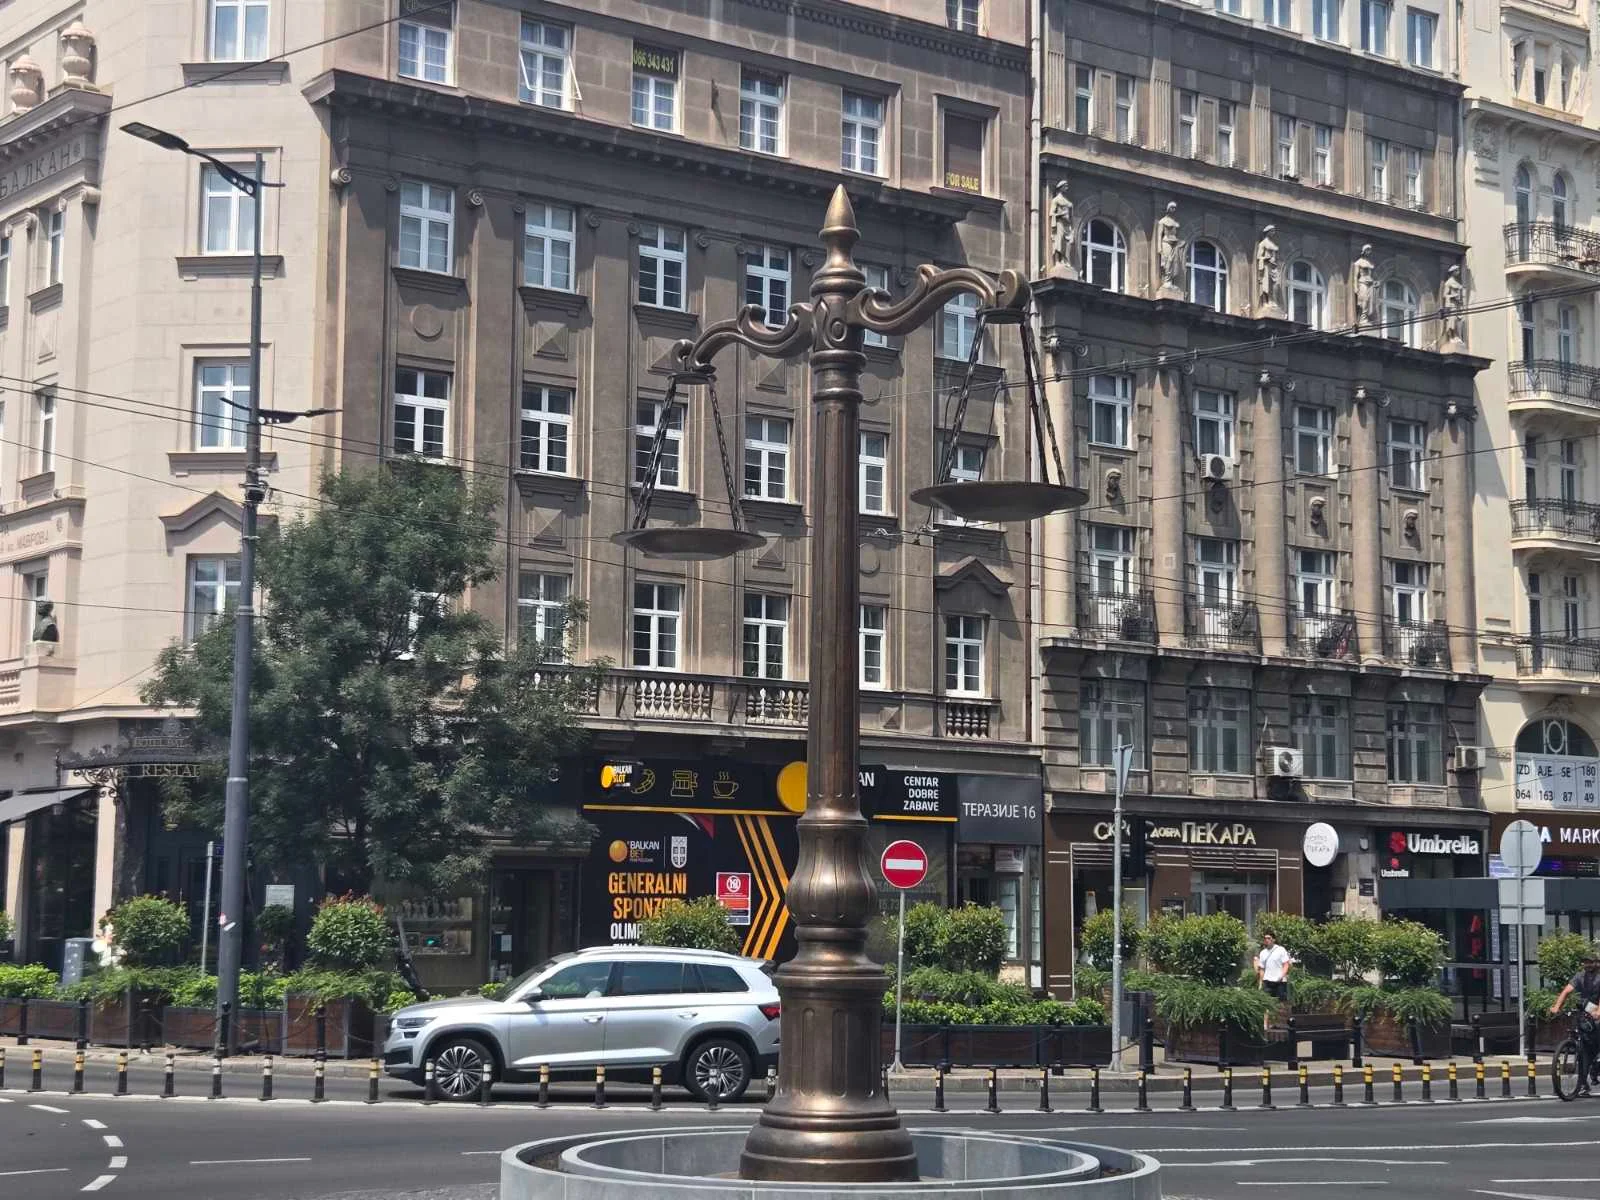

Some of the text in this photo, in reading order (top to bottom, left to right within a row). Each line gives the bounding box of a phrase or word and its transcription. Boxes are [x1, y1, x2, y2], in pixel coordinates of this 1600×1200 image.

[946, 172, 979, 192] FOR SALE
[1538, 765, 1553, 777] AJE
[1561, 766, 1572, 778] SE
[1582, 766, 1596, 777] 180
[903, 775, 939, 787] CENTAR
[908, 788, 939, 799] DOBRE
[1516, 789, 1595, 804] 064 163 87 49
[903, 800, 939, 811] ZABAVE
[962, 802, 1036, 819] ТЕРАЗИЈЕ 16
[1181, 821, 1257, 845] ПЕКАРА
[630, 840, 660, 850] BALKAN
[1407, 833, 1480, 854] Umbrella
[608, 872, 687, 894] GENERALNI
